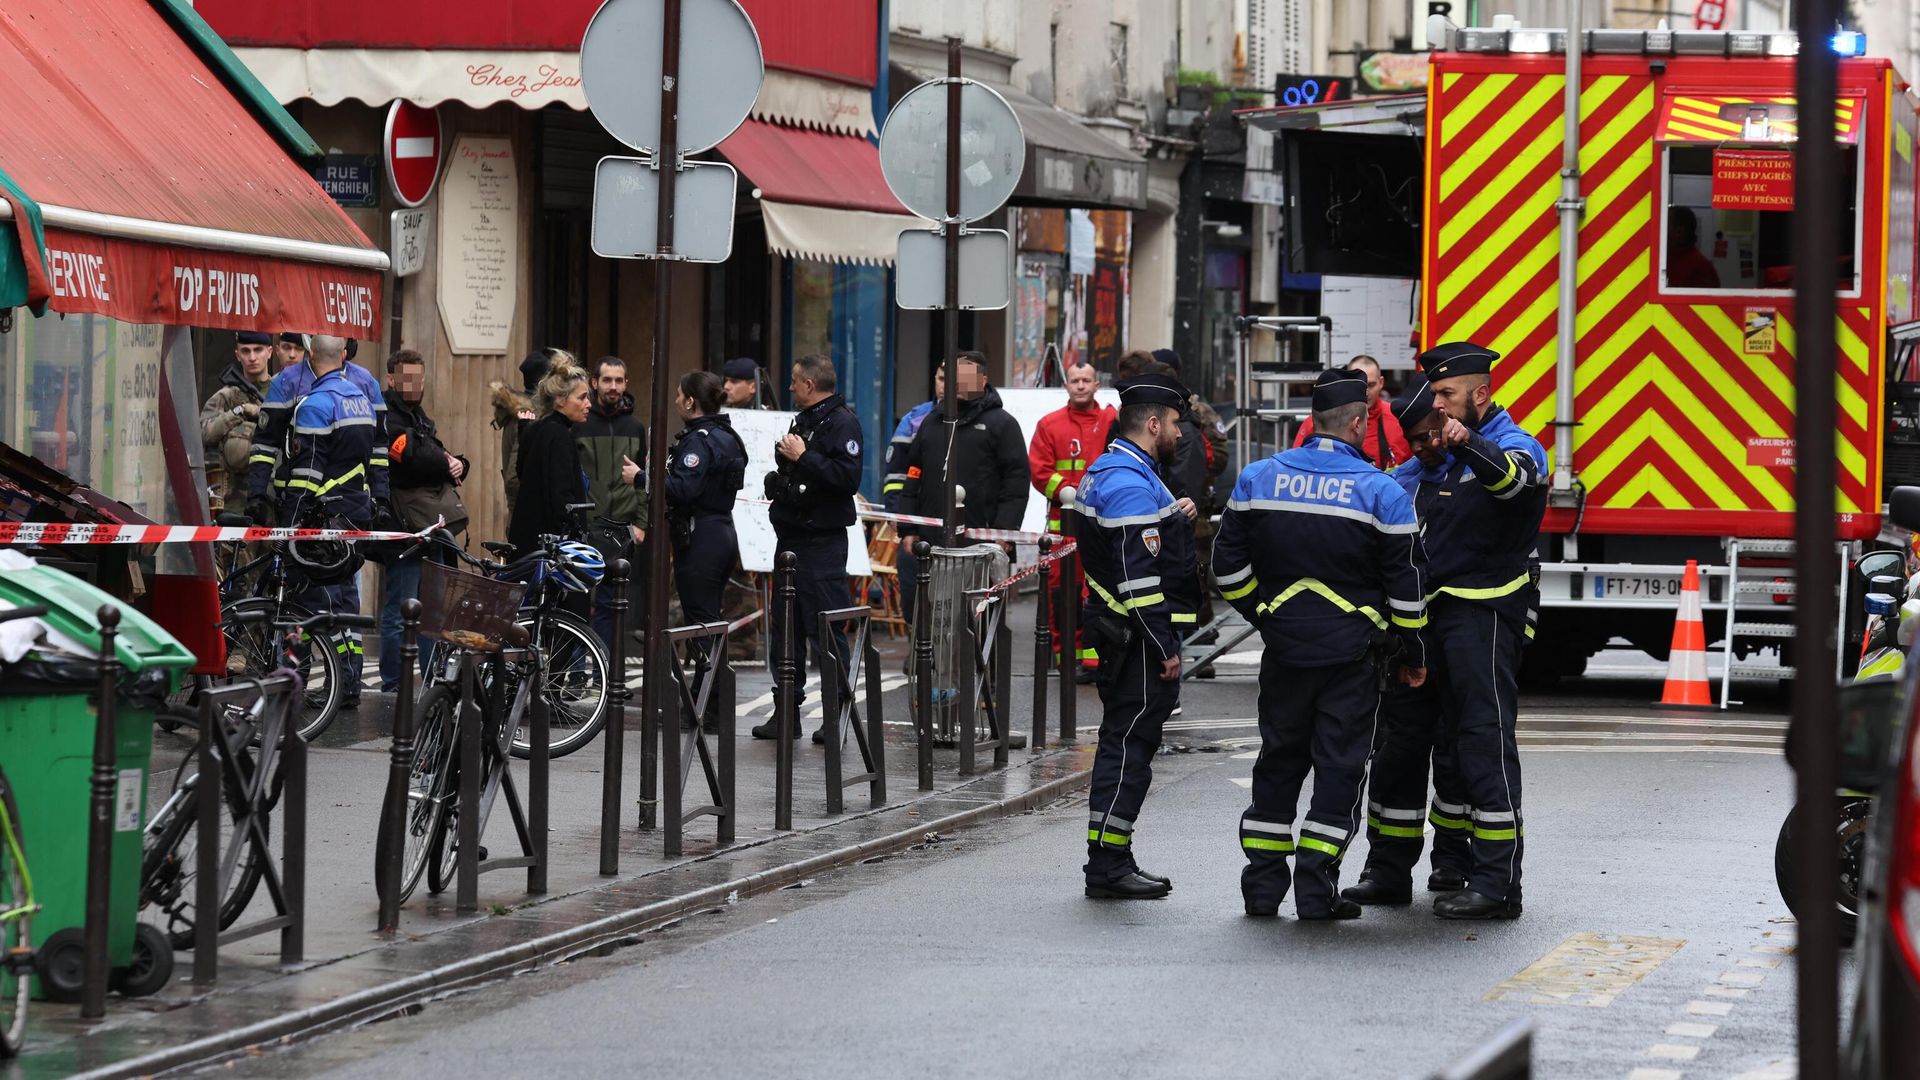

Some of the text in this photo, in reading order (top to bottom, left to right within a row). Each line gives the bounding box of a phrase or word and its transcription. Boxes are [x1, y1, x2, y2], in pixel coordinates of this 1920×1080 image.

[466, 64, 529, 97] Chez
[1718, 158, 1792, 169] PRÉSENTATION
[327, 166, 359, 179] RUE
[1717, 171, 1749, 179] CHEFS
[1742, 184, 1767, 192] AVEC
[1712, 194, 1740, 203] JETON
[403, 214, 424, 230] SAUF
[174, 266, 203, 312] TOP
[208, 269, 260, 318] FRUITS
[134, 363, 157, 399] 8h30
[1781, 448, 1792, 456] DE
[1274, 473, 1355, 504] POLICE
[1841, 513, 1853, 523] 32
[1, 524, 109, 534] POMPIERS DE PARIS
[251, 529, 308, 537] POMPIERS
[81, 534, 132, 542] INTERDIT
[1607, 578, 1683, 596] FT-719-Q
